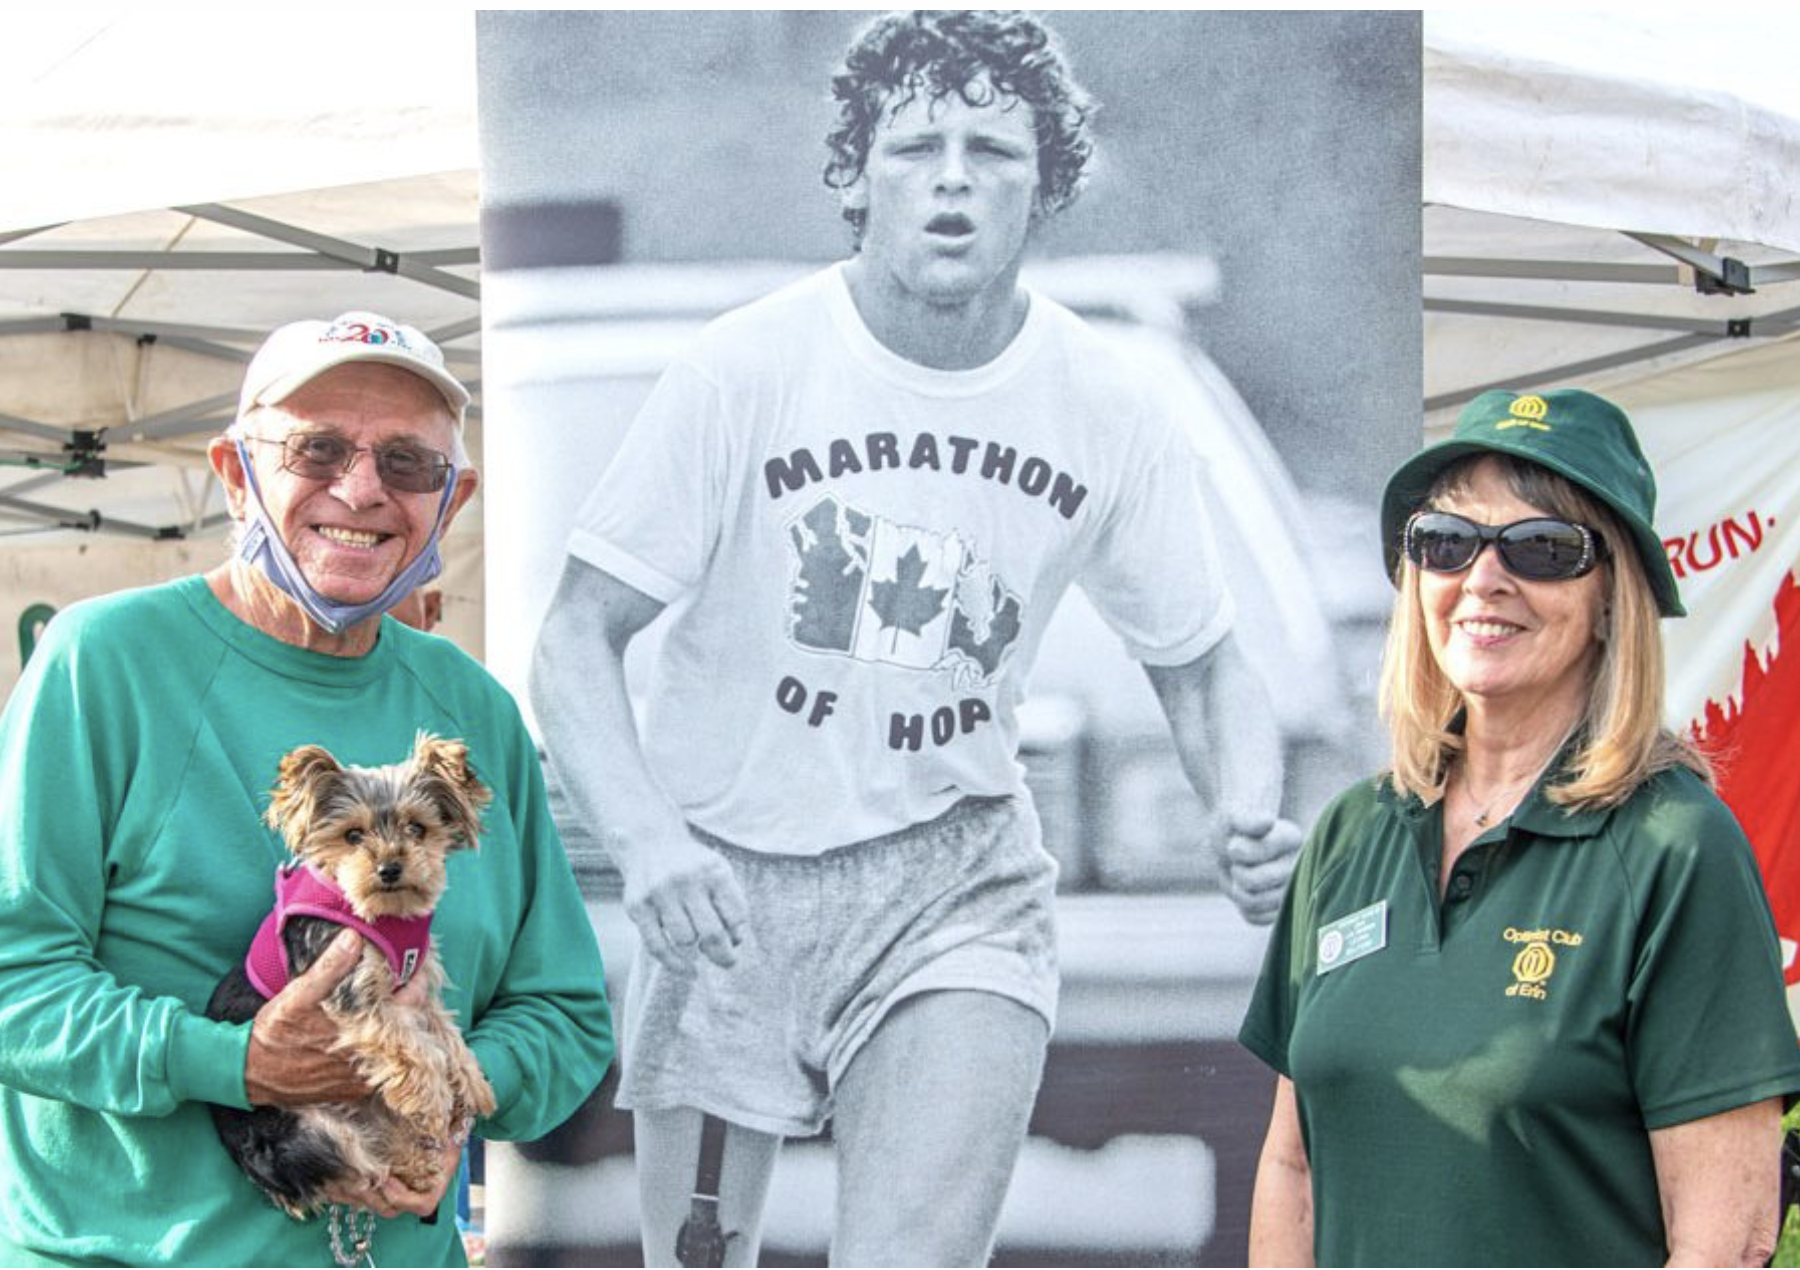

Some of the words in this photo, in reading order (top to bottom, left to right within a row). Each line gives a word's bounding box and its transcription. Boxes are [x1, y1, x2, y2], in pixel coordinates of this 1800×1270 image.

[347, 322, 389, 345] 20
[764, 432, 1088, 520] MARATHON
[776, 675, 838, 727] OF
[888, 697, 991, 752] HOP
[1552, 929, 1583, 946] Club
